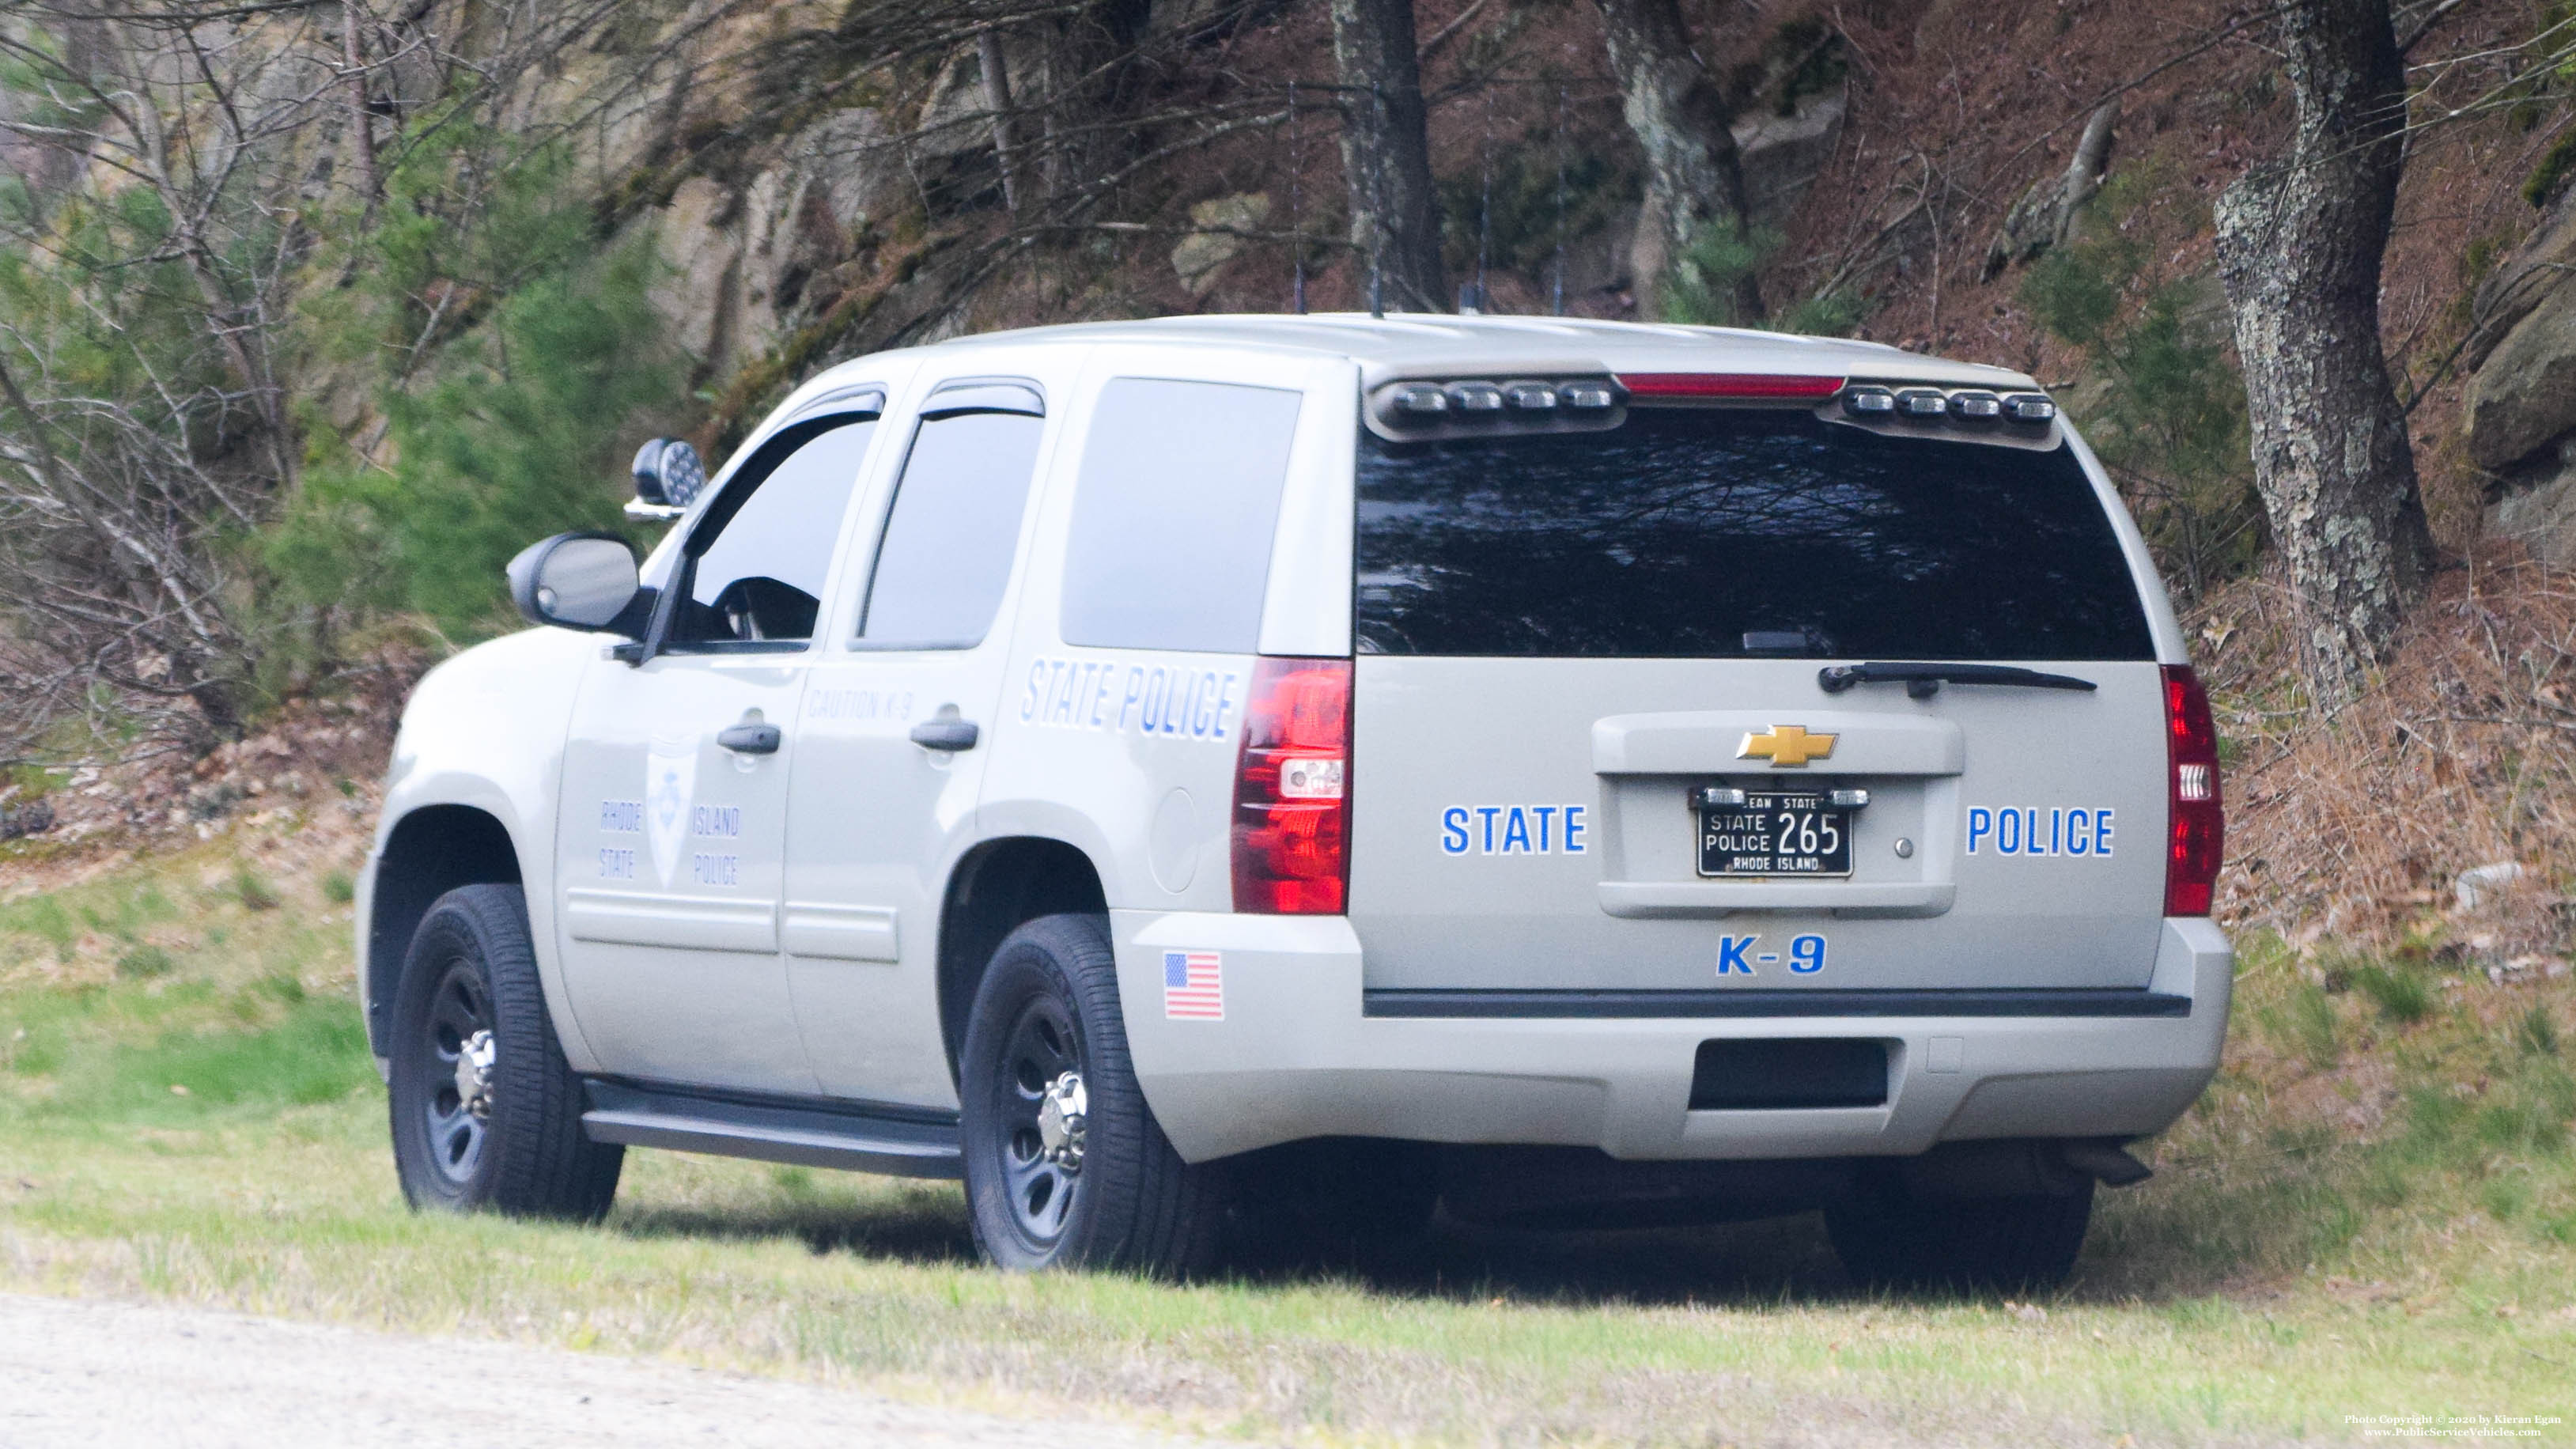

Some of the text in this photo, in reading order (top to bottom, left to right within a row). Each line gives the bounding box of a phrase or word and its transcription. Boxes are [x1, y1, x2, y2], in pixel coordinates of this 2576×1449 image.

[1019, 657, 1236, 741] STATE POLICE
[601, 800, 740, 838] RHODE ISLAND
[1742, 798, 1817, 809] EAN STATE
[1441, 804, 2116, 858] STATE POLICE
[1711, 815, 1766, 831] STATE
[1779, 812, 1839, 855] 265
[1706, 834, 1771, 852] POLICE
[600, 849, 739, 887] STATE POLICE
[1733, 857, 1819, 871] RHODE ISLAND
[1716, 933, 1828, 977] K-9
